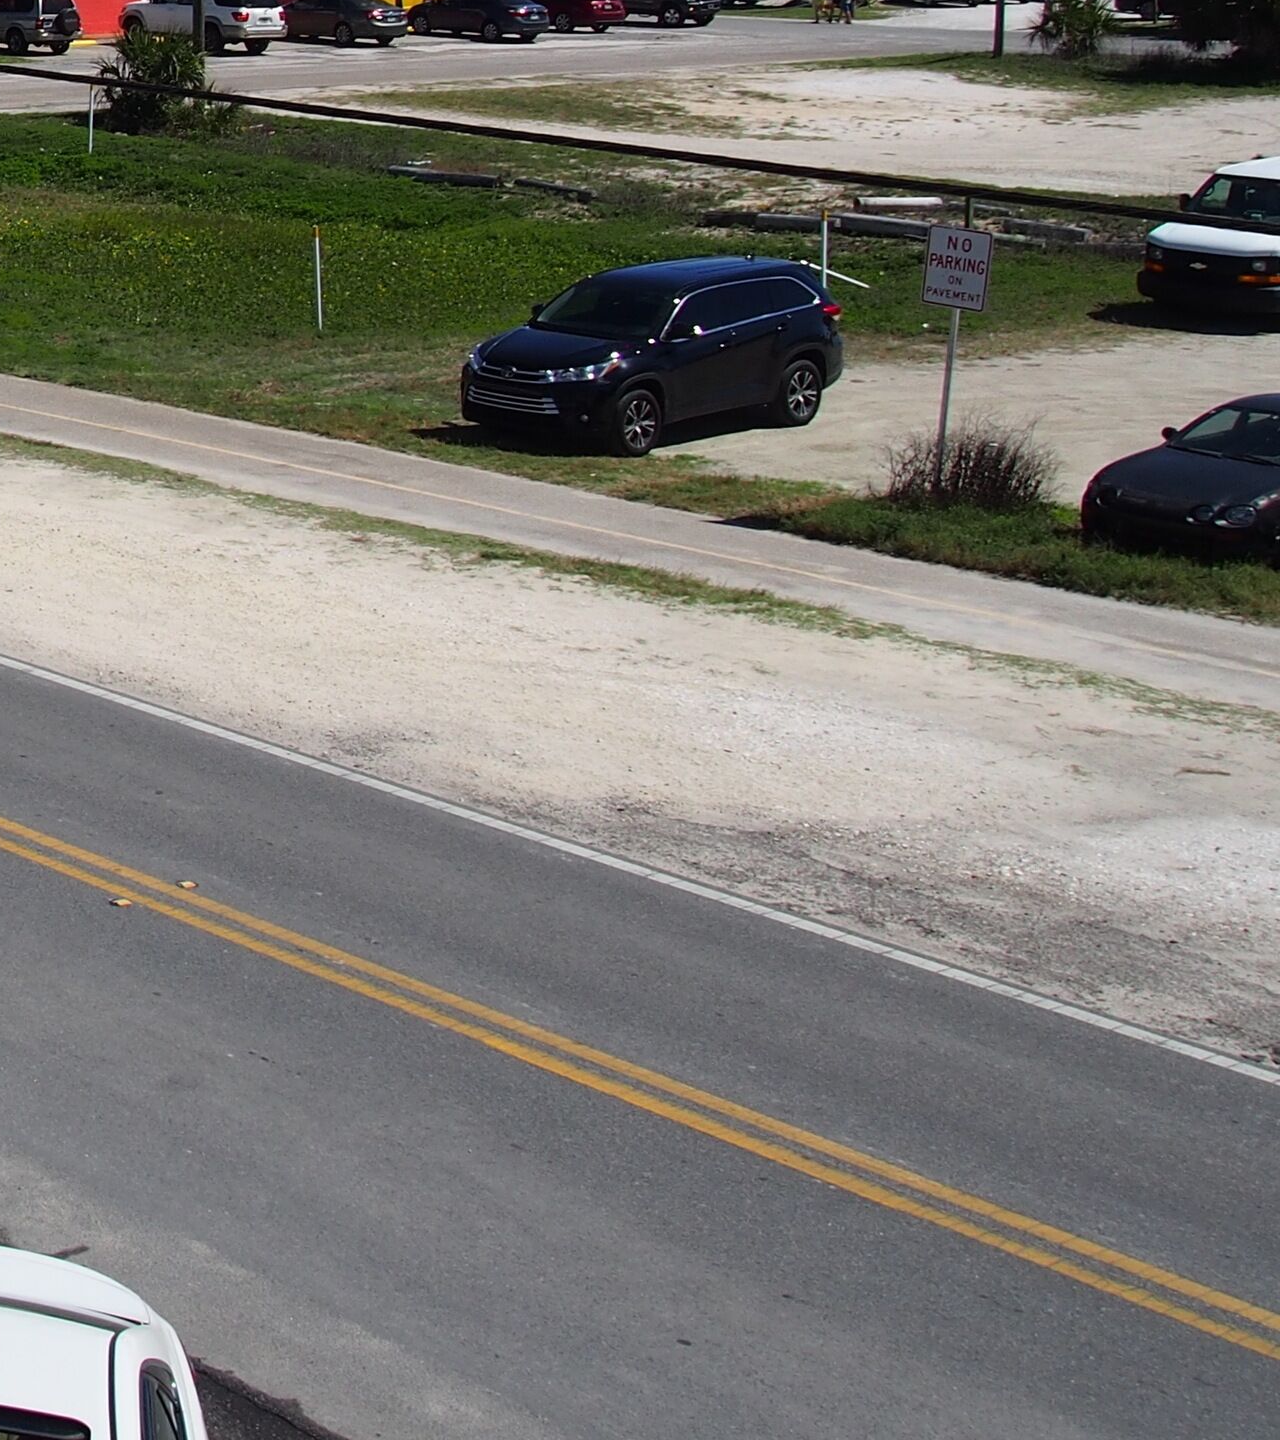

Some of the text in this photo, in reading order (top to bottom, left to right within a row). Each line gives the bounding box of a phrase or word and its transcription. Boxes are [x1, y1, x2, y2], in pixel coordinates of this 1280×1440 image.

[947, 236, 973, 253] NO
[929, 253, 986, 275] PARKING
[948, 275, 963, 286] ON
[926, 286, 981, 302] PAVEMENT
